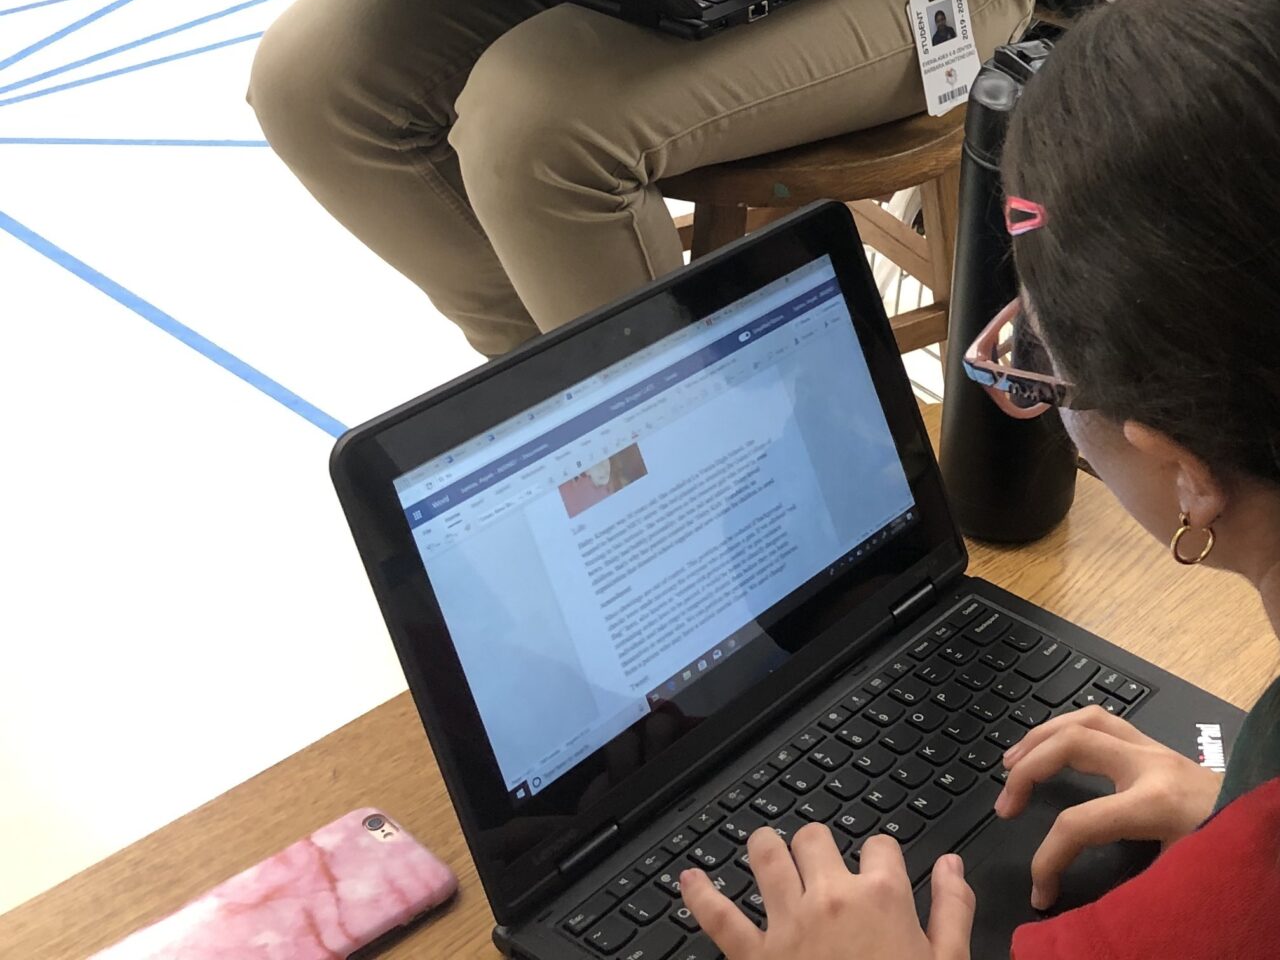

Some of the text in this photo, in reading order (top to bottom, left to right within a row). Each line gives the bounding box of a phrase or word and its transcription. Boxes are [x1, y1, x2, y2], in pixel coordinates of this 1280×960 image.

[916, 11, 930, 55] STUDENT
[960, 19, 969, 40] 2019
[923, 746, 935, 756] K
[858, 756, 871, 766] U
[830, 779, 843, 790] Y
[940, 774, 955, 785] M
[868, 792, 883, 802] H
[801, 803, 814, 813] T
[914, 798, 928, 808] N
[842, 815, 855, 825] G
[886, 822, 899, 833] B
